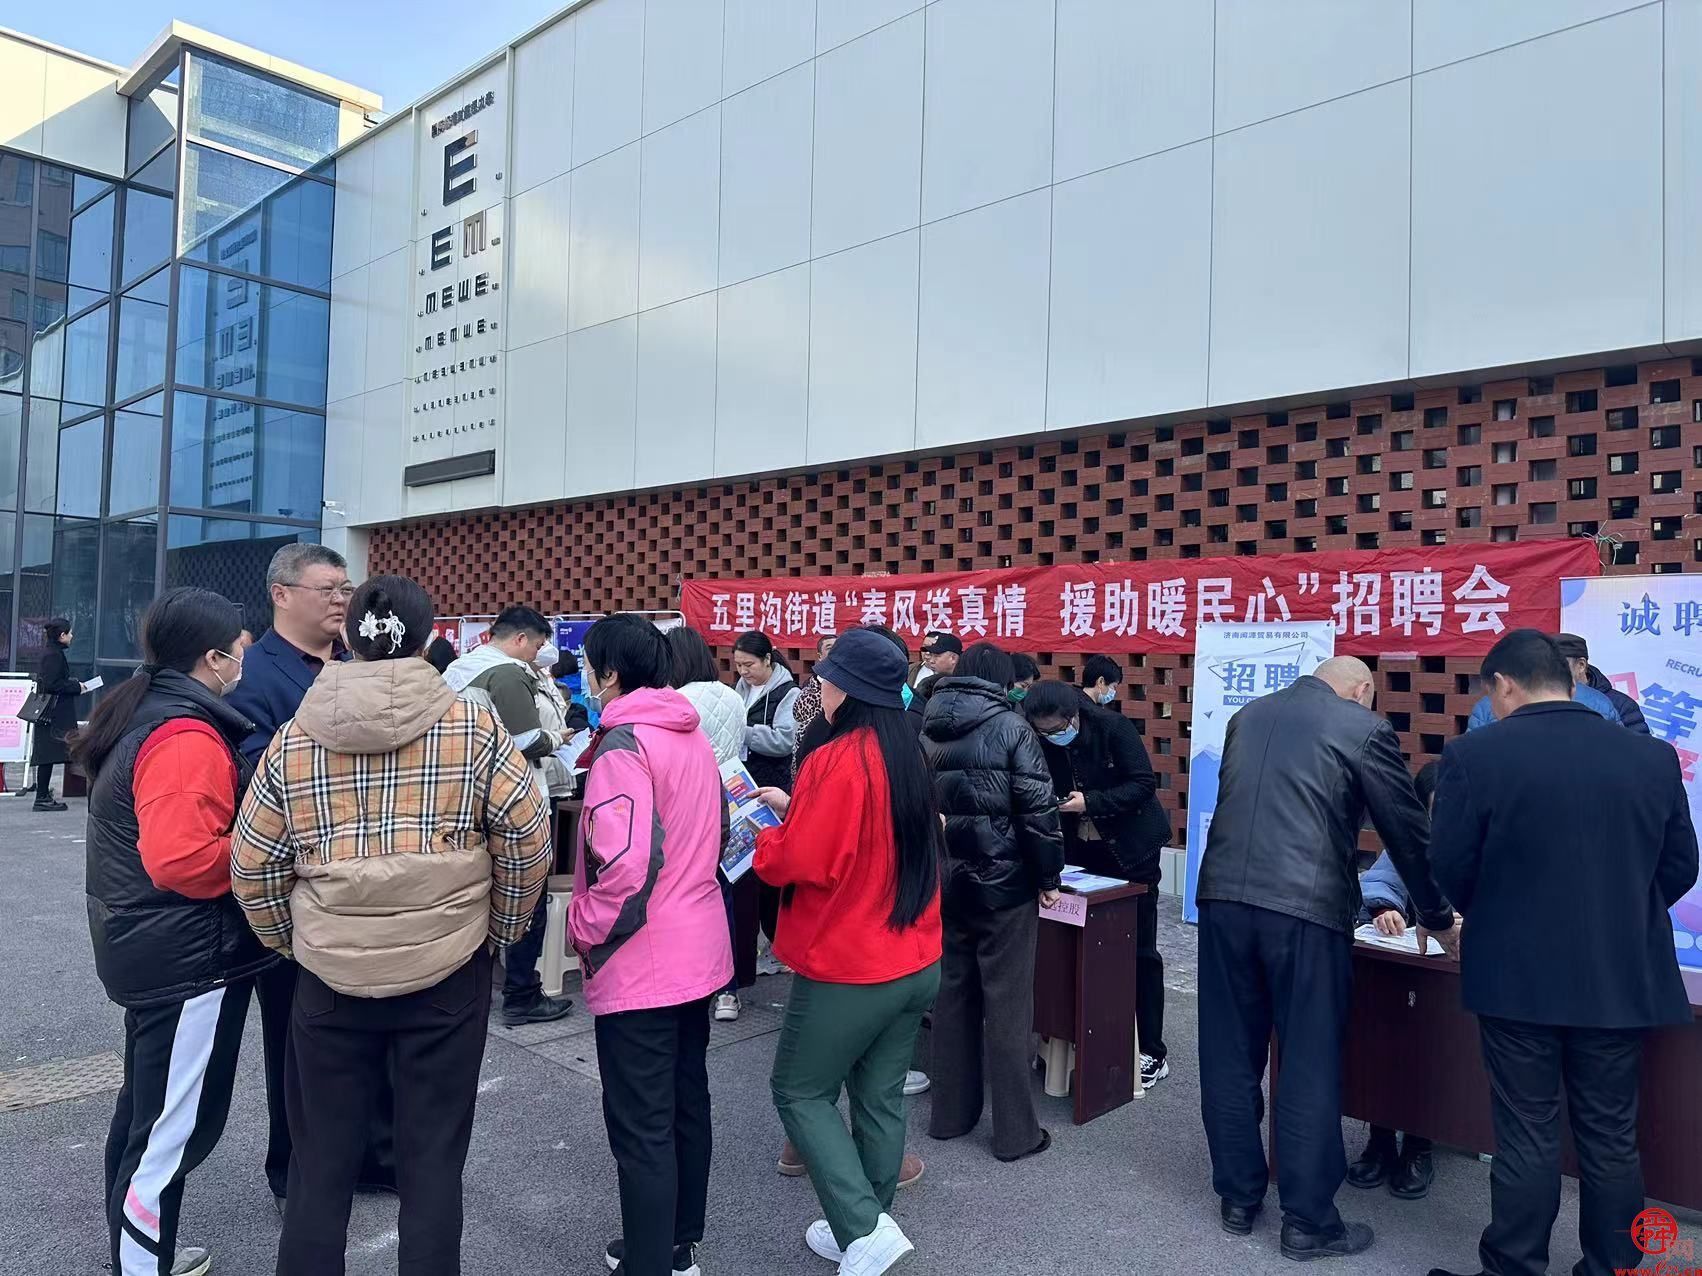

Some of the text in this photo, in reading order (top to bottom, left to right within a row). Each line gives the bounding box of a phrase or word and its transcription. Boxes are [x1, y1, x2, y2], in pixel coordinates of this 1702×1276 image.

[710, 583, 1028, 638] 五里沟街道“春风送真情
[1060, 563, 1510, 638] 援助暖民心”招聘会
[1223, 662, 1300, 693] 招聘
[1227, 696, 1244, 704] YOU
[1052, 900, 1080, 916] 控股
